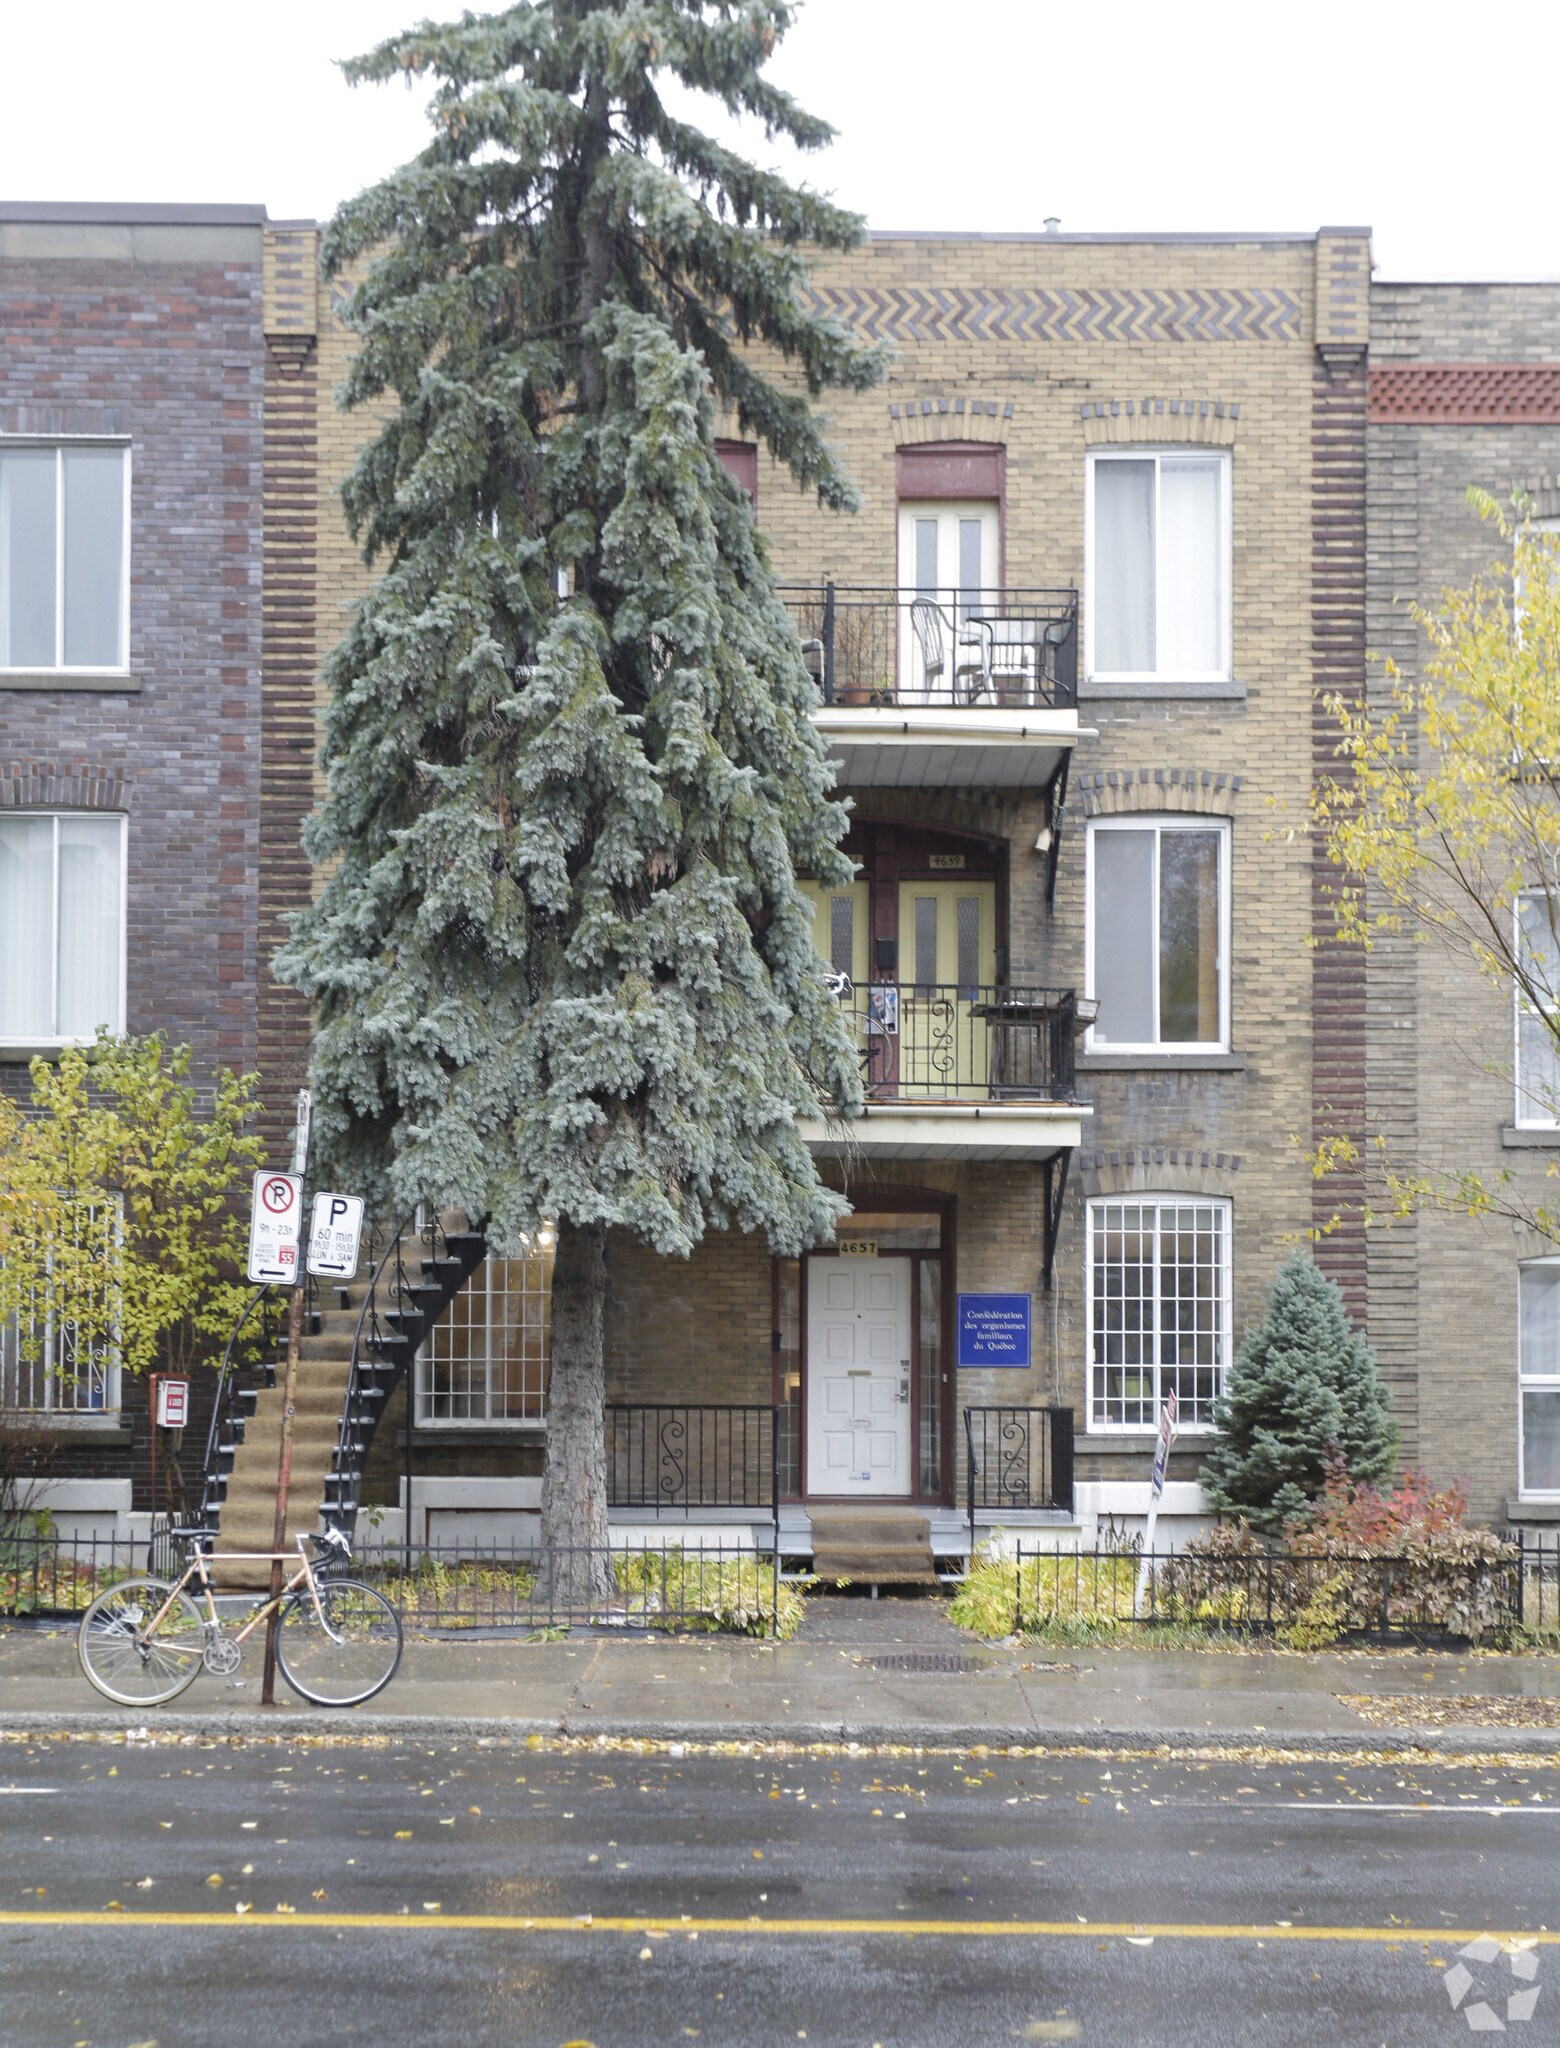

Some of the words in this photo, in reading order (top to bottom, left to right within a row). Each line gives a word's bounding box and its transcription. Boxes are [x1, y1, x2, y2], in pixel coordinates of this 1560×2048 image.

[330, 1199, 348, 1226] P
[260, 1223, 270, 1233] 9h
[278, 1225, 293, 1235] 23h
[318, 1228, 331, 1240] 60
[335, 1231, 353, 1243] min
[841, 1242, 876, 1254] 4657
[280, 1252, 293, 1264] 55
[966, 1310, 1024, 1320] Confédération
[963, 1320, 978, 1330] des
[981, 1321, 1026, 1331] organismes
[976, 1331, 1014, 1340] familiaux
[973, 1341, 984, 1350] du
[987, 1341, 1017, 1351] Québec
